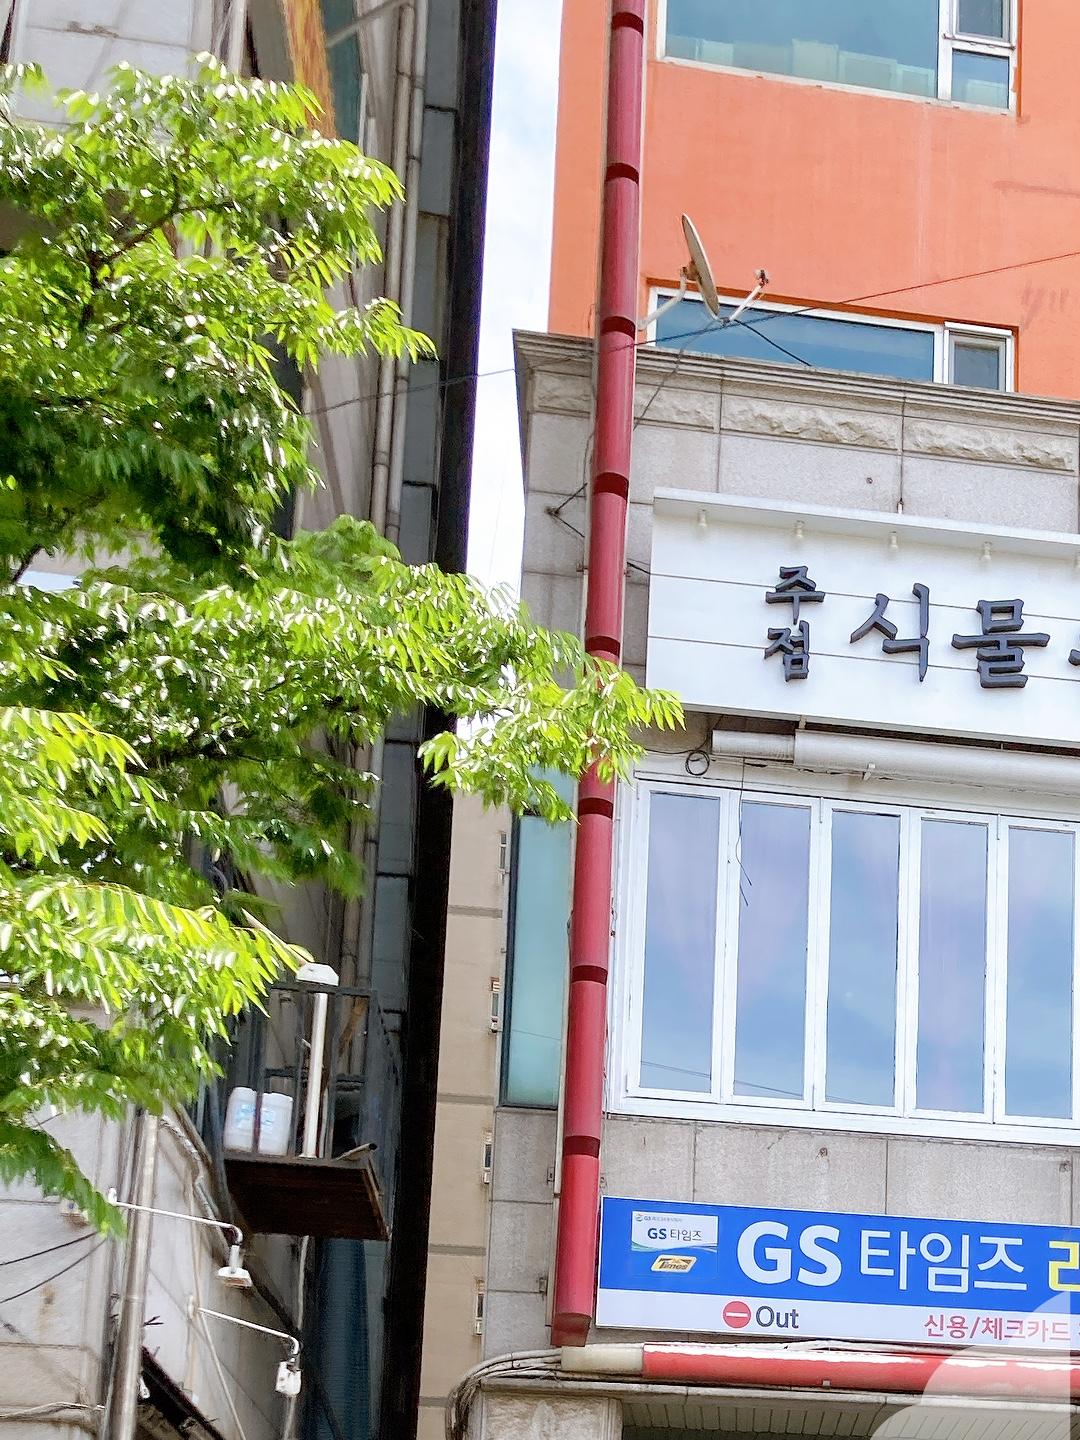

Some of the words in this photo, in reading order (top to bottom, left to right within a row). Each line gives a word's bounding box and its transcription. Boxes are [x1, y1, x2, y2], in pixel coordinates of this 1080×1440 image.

[647, 1227, 667, 1240] GS
[669, 1228, 703, 1242] 타임즈
[736, 1220, 843, 1287] GS
[859, 1229, 1028, 1294] 타임즈
[754, 1304, 800, 1330] Out
[924, 1314, 1071, 1342] 신용/체크카드
